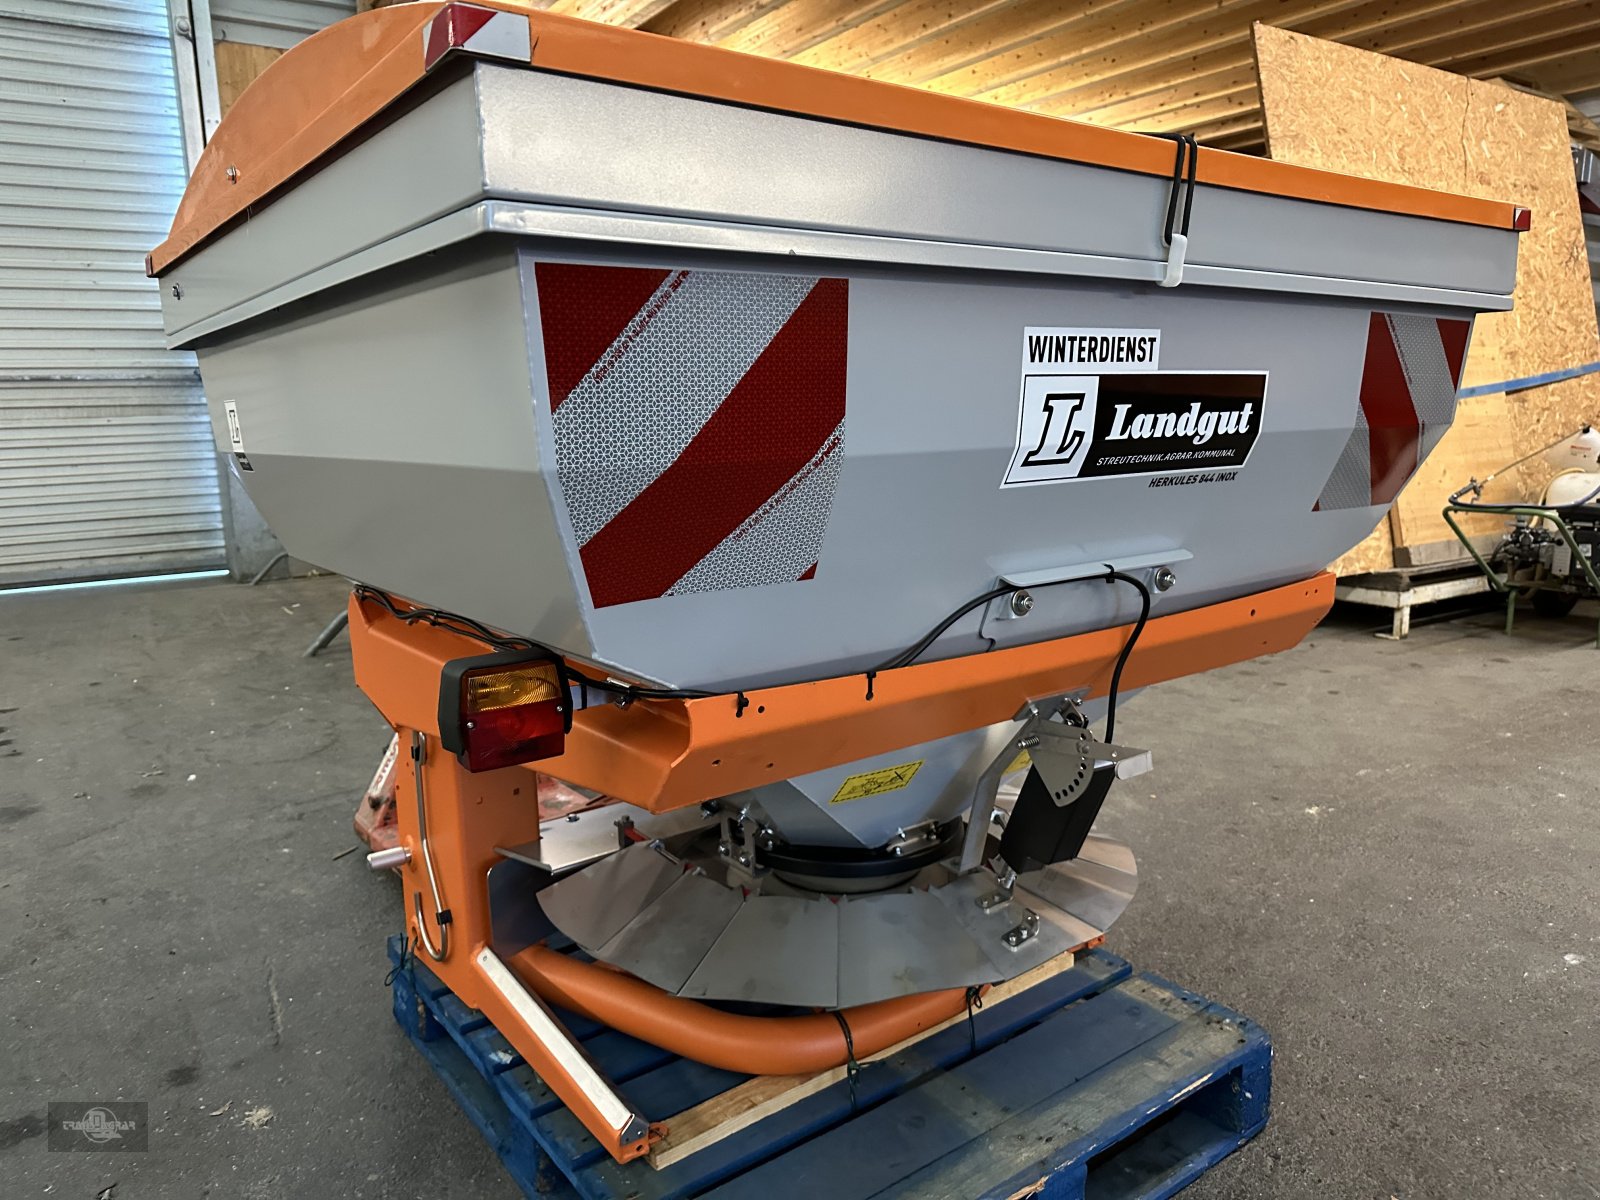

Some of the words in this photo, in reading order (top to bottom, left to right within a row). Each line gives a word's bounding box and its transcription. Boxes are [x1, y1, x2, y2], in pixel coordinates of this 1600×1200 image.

[1028, 335, 1157, 363] WINTERDIENST
[1021, 393, 1086, 467] L
[1104, 402, 1254, 445] Landgut
[1096, 449, 1236, 466] STREUTECHNIK.AGRAR.KOMMUNAL
[1148, 474, 1199, 488] HERKULES
[1198, 473, 1215, 484] 844
[1215, 471, 1239, 482] INOX
